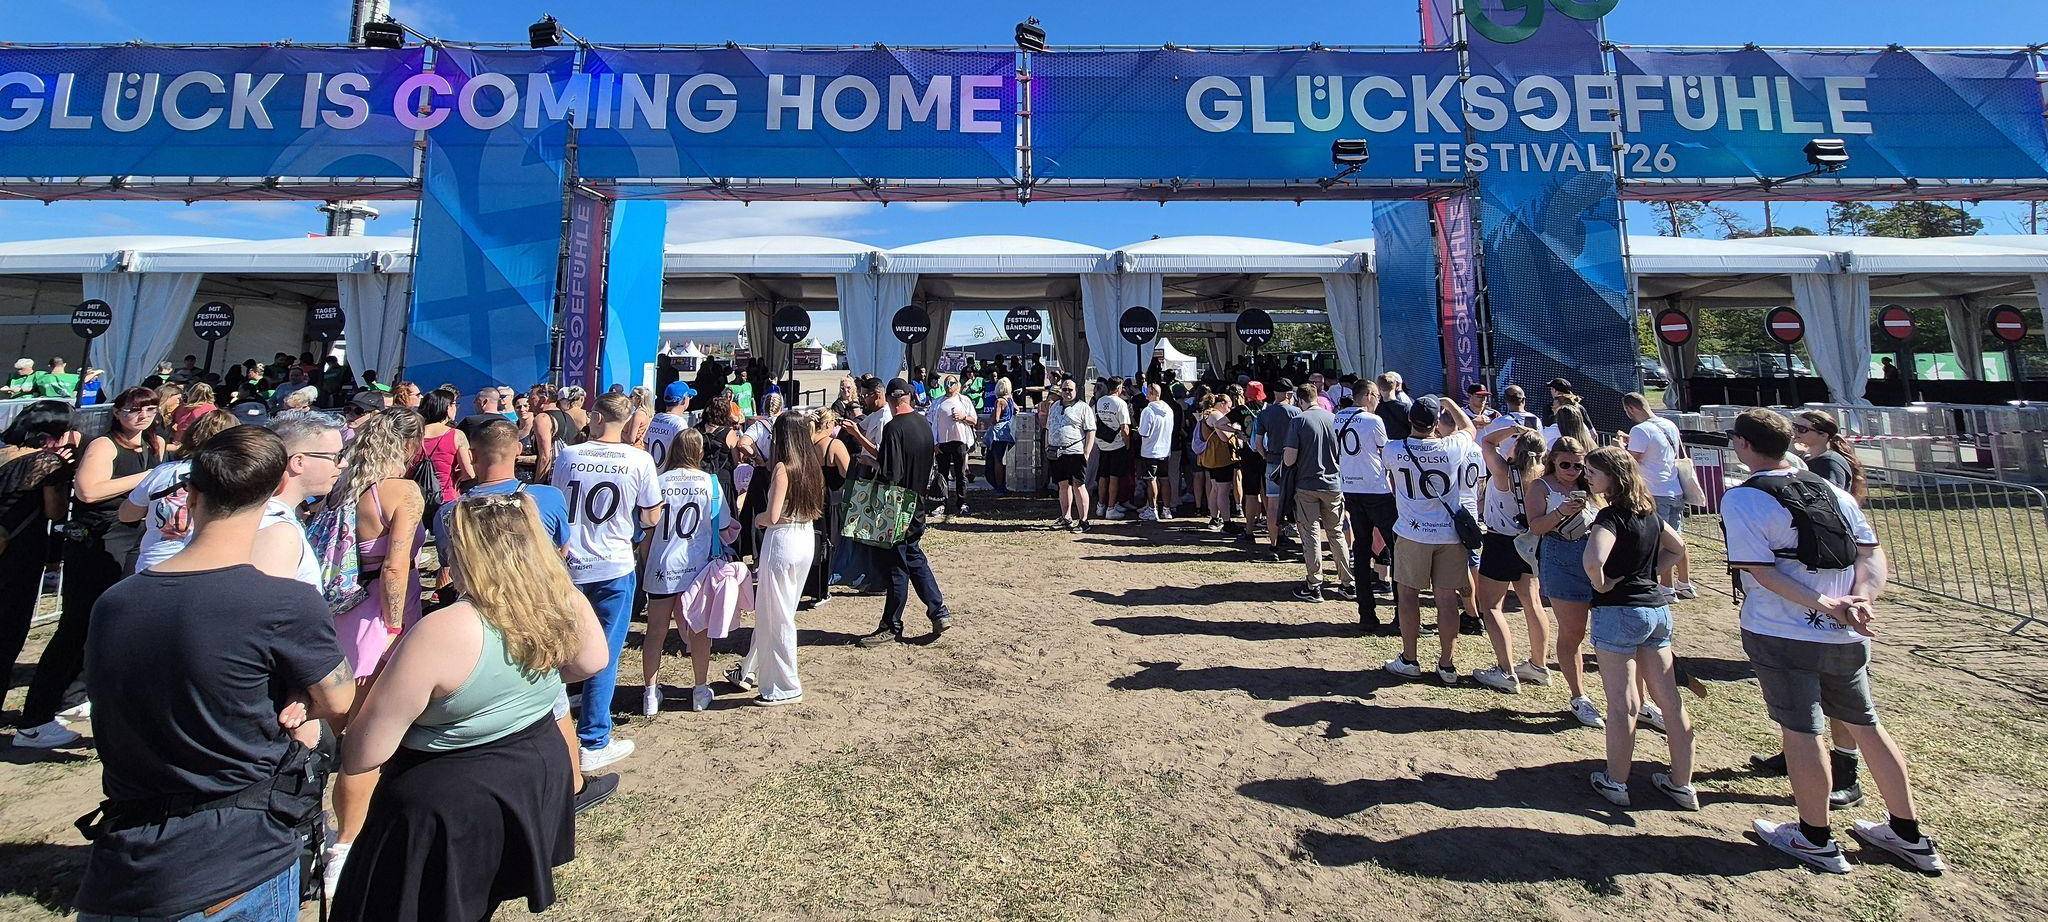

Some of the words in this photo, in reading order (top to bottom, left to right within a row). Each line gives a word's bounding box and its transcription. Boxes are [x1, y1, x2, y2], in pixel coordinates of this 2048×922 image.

[0, 71, 284, 132] GLÜCK
[300, 72, 370, 130] IS
[393, 73, 737, 133] COMING
[766, 74, 1002, 133] HOME
[1185, 74, 1873, 134] GLÜCKSGEFÜHLE
[1414, 143, 1611, 172] FESTIVAL
[72, 317, 110, 325] BÄNDCHEN
[1005, 323, 1041, 331] BÄNDCHEN
[569, 462, 629, 475] PODOLSKI
[1398, 467, 1451, 500] 10
[567, 480, 621, 526] 10
[661, 501, 701, 541] 10
